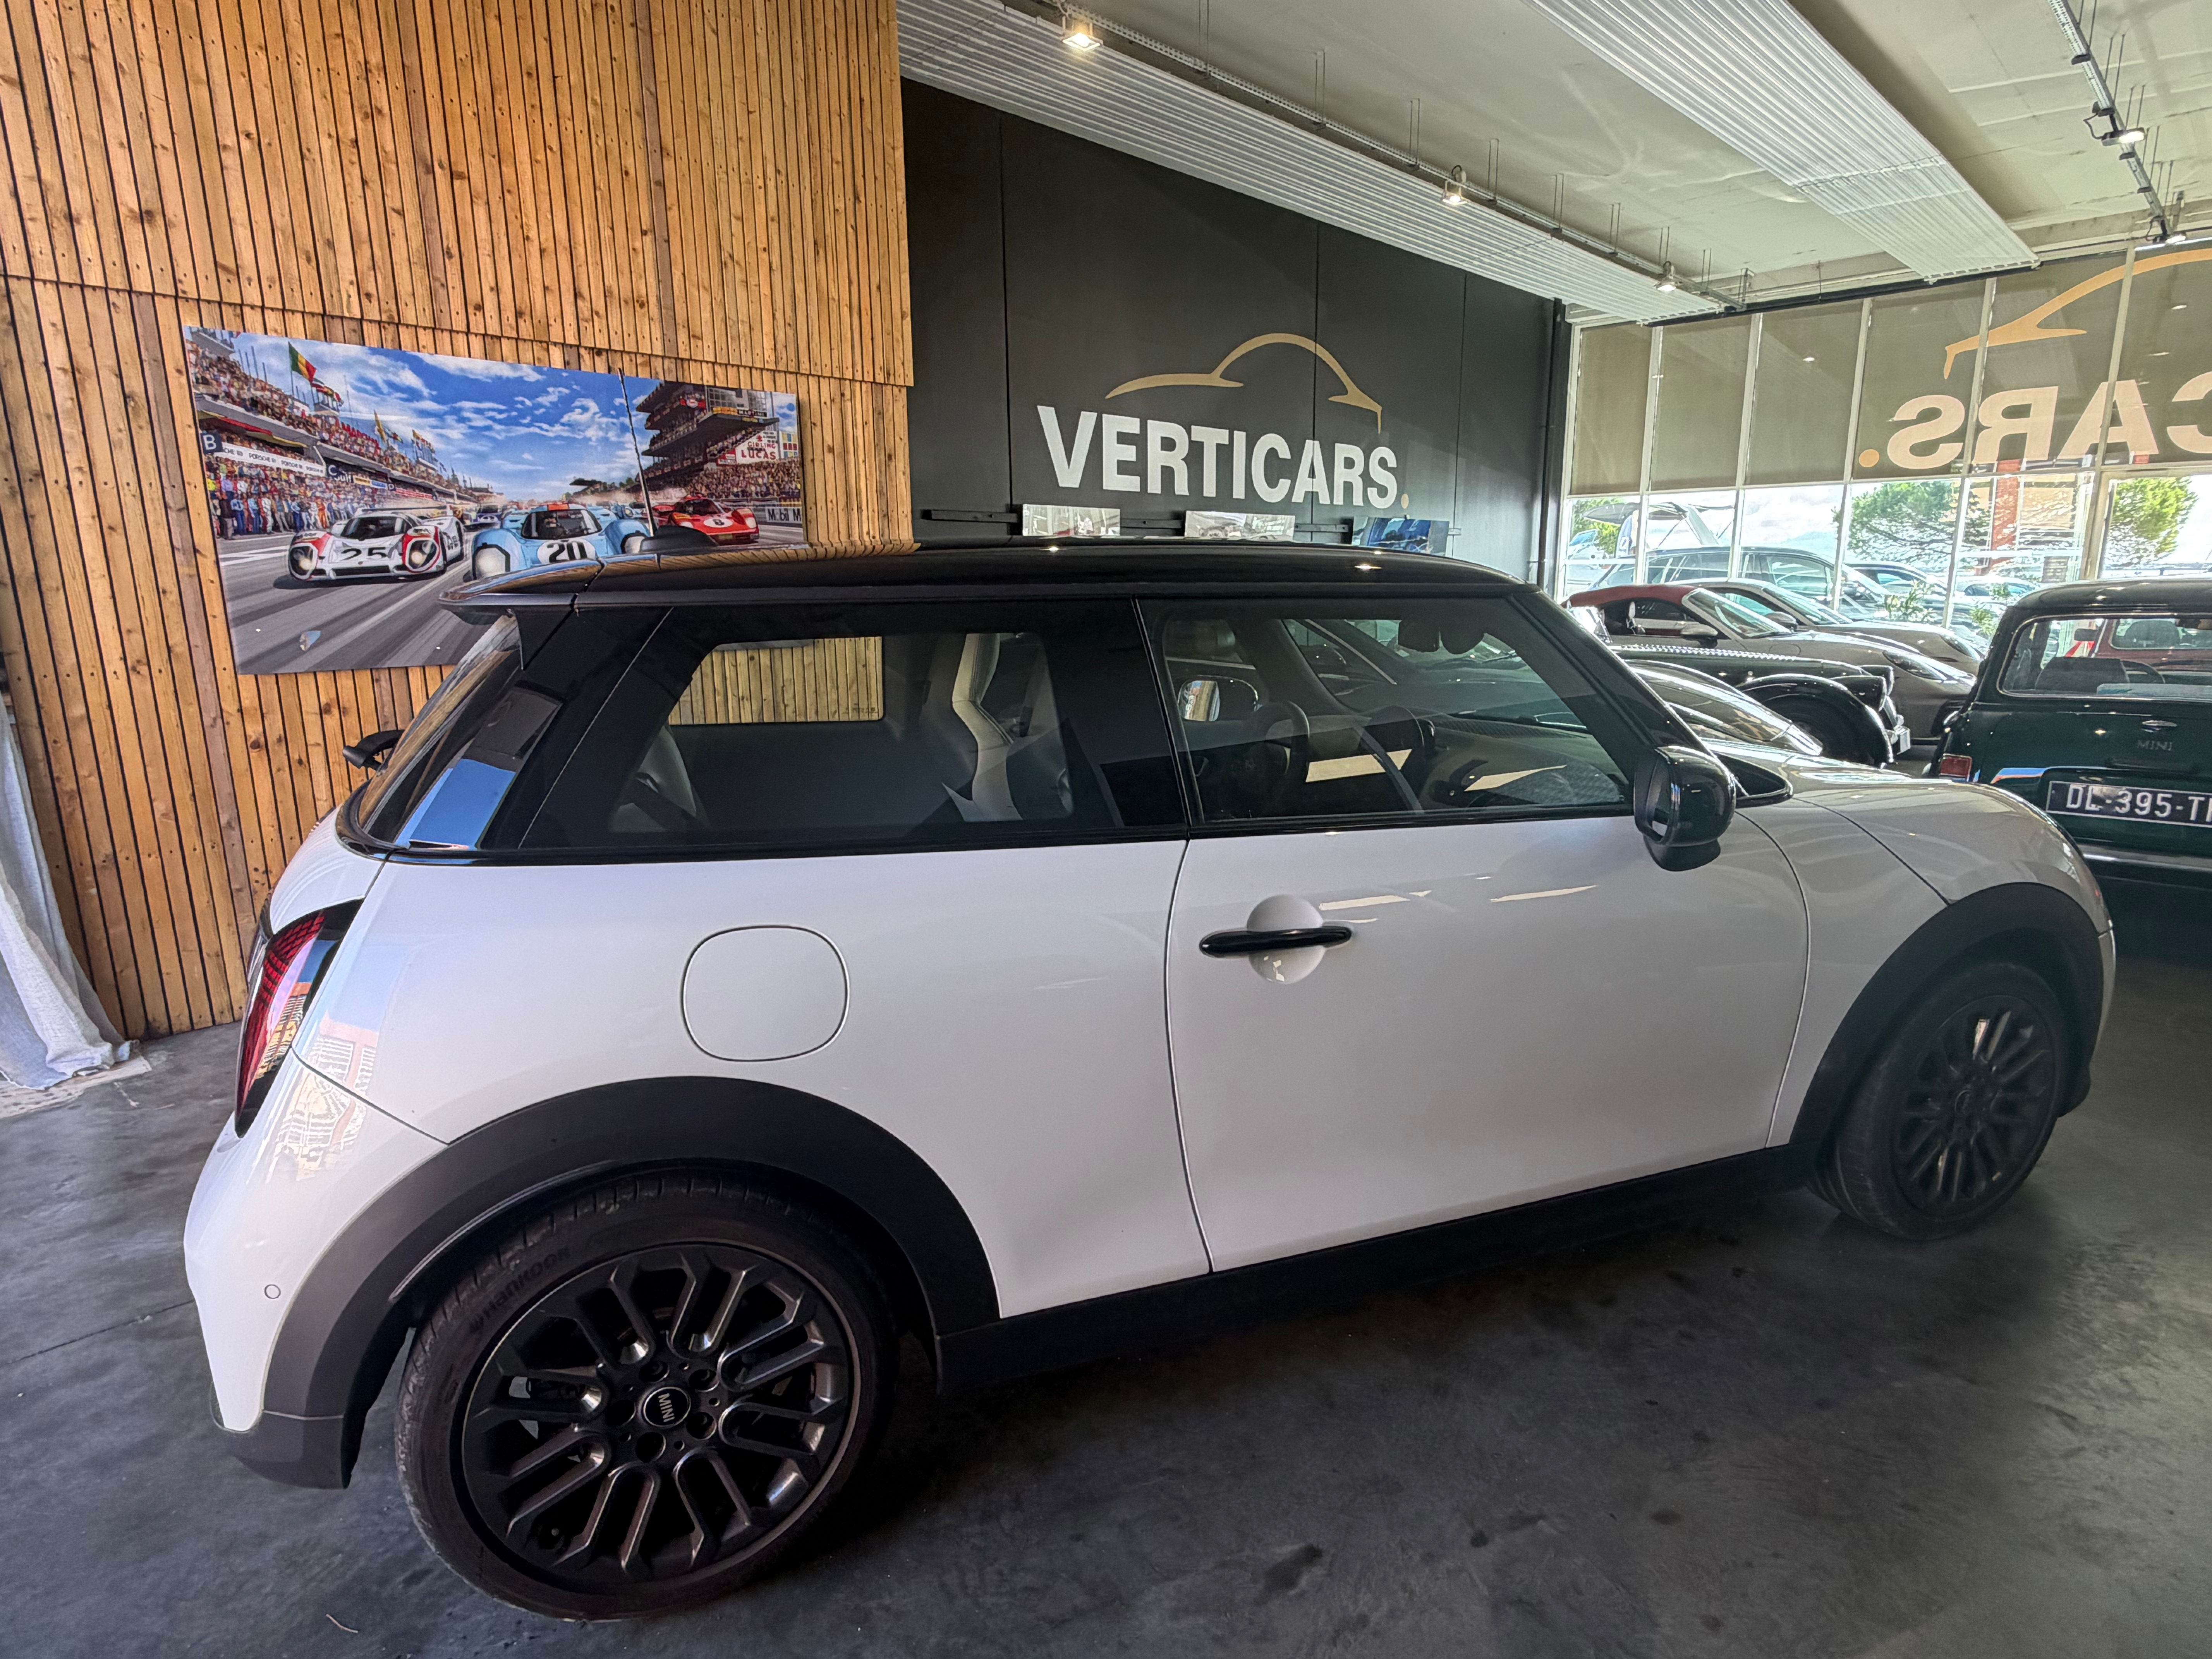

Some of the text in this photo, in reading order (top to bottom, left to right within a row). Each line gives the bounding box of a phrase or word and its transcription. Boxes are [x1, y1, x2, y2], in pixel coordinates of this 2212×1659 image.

[203, 434, 216, 450] B
[741, 449, 776, 460] LUCAS
[328, 465, 337, 476] C
[547, 542, 588, 563] 20
[2137, 739, 2173, 751] MINI
[658, 1393, 675, 1422] MINI
